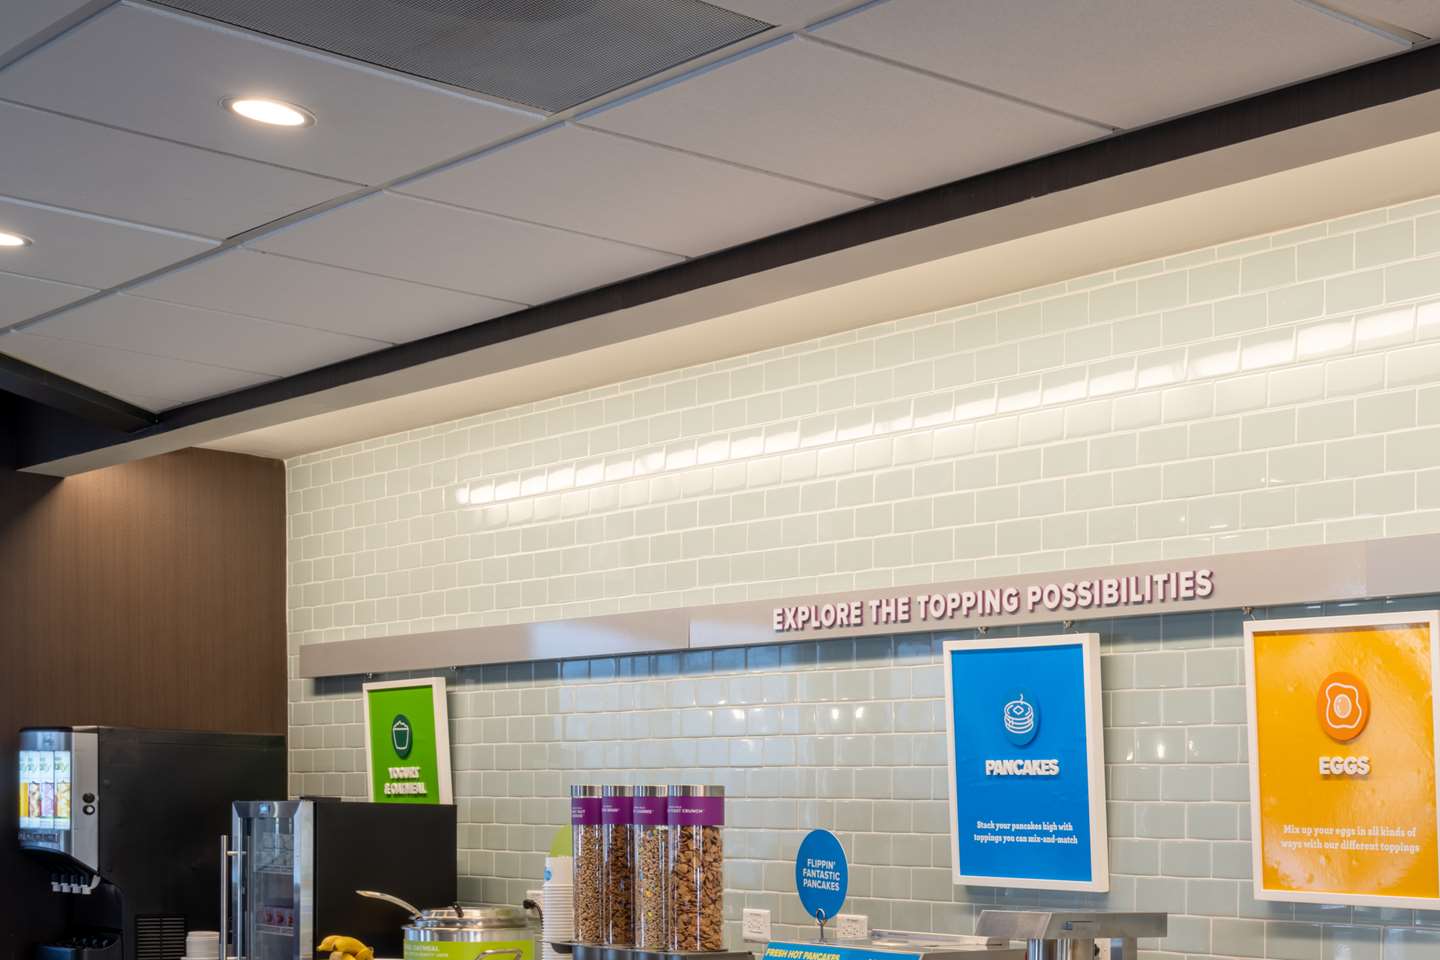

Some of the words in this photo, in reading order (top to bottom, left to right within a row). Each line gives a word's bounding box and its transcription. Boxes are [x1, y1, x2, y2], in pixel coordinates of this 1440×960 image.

[773, 601, 863, 632] EXPLORE
[868, 597, 911, 625] THE
[917, 587, 1021, 621] TOPPING
[1027, 569, 1213, 613] POSSIBILITIES
[985, 759, 1060, 775] PANCAKES
[1318, 756, 1370, 775] EGGS
[976, 820, 995, 829] Stack
[995, 823, 1011, 831] your
[1011, 821, 1041, 832] pancakes
[1042, 821, 1057, 832] high
[1058, 822, 1073, 831] with
[1283, 824, 1300, 834] Mix
[1302, 827, 1312, 837] up
[1313, 827, 1334, 838] your
[1335, 828, 1356, 838] eggs
[1357, 826, 1366, 836] in
[1367, 825, 1379, 837] all
[1380, 826, 1405, 838] kinds
[1407, 827, 1417, 838] of
[974, 833, 1002, 844] toppings
[1002, 835, 1015, 844] you
[1028, 834, 1078, 844] mix-and-match
[1302, 839, 1322, 849] with
[1323, 841, 1339, 849] our
[1341, 840, 1379, 851] different
[1380, 842, 1420, 854] toppings
[807, 858, 836, 870] FLIPPIN'
[802, 868, 841, 881] FANTASTIC
[803, 878, 840, 891] PANCAKES
[788, 950, 803, 960] HOT
